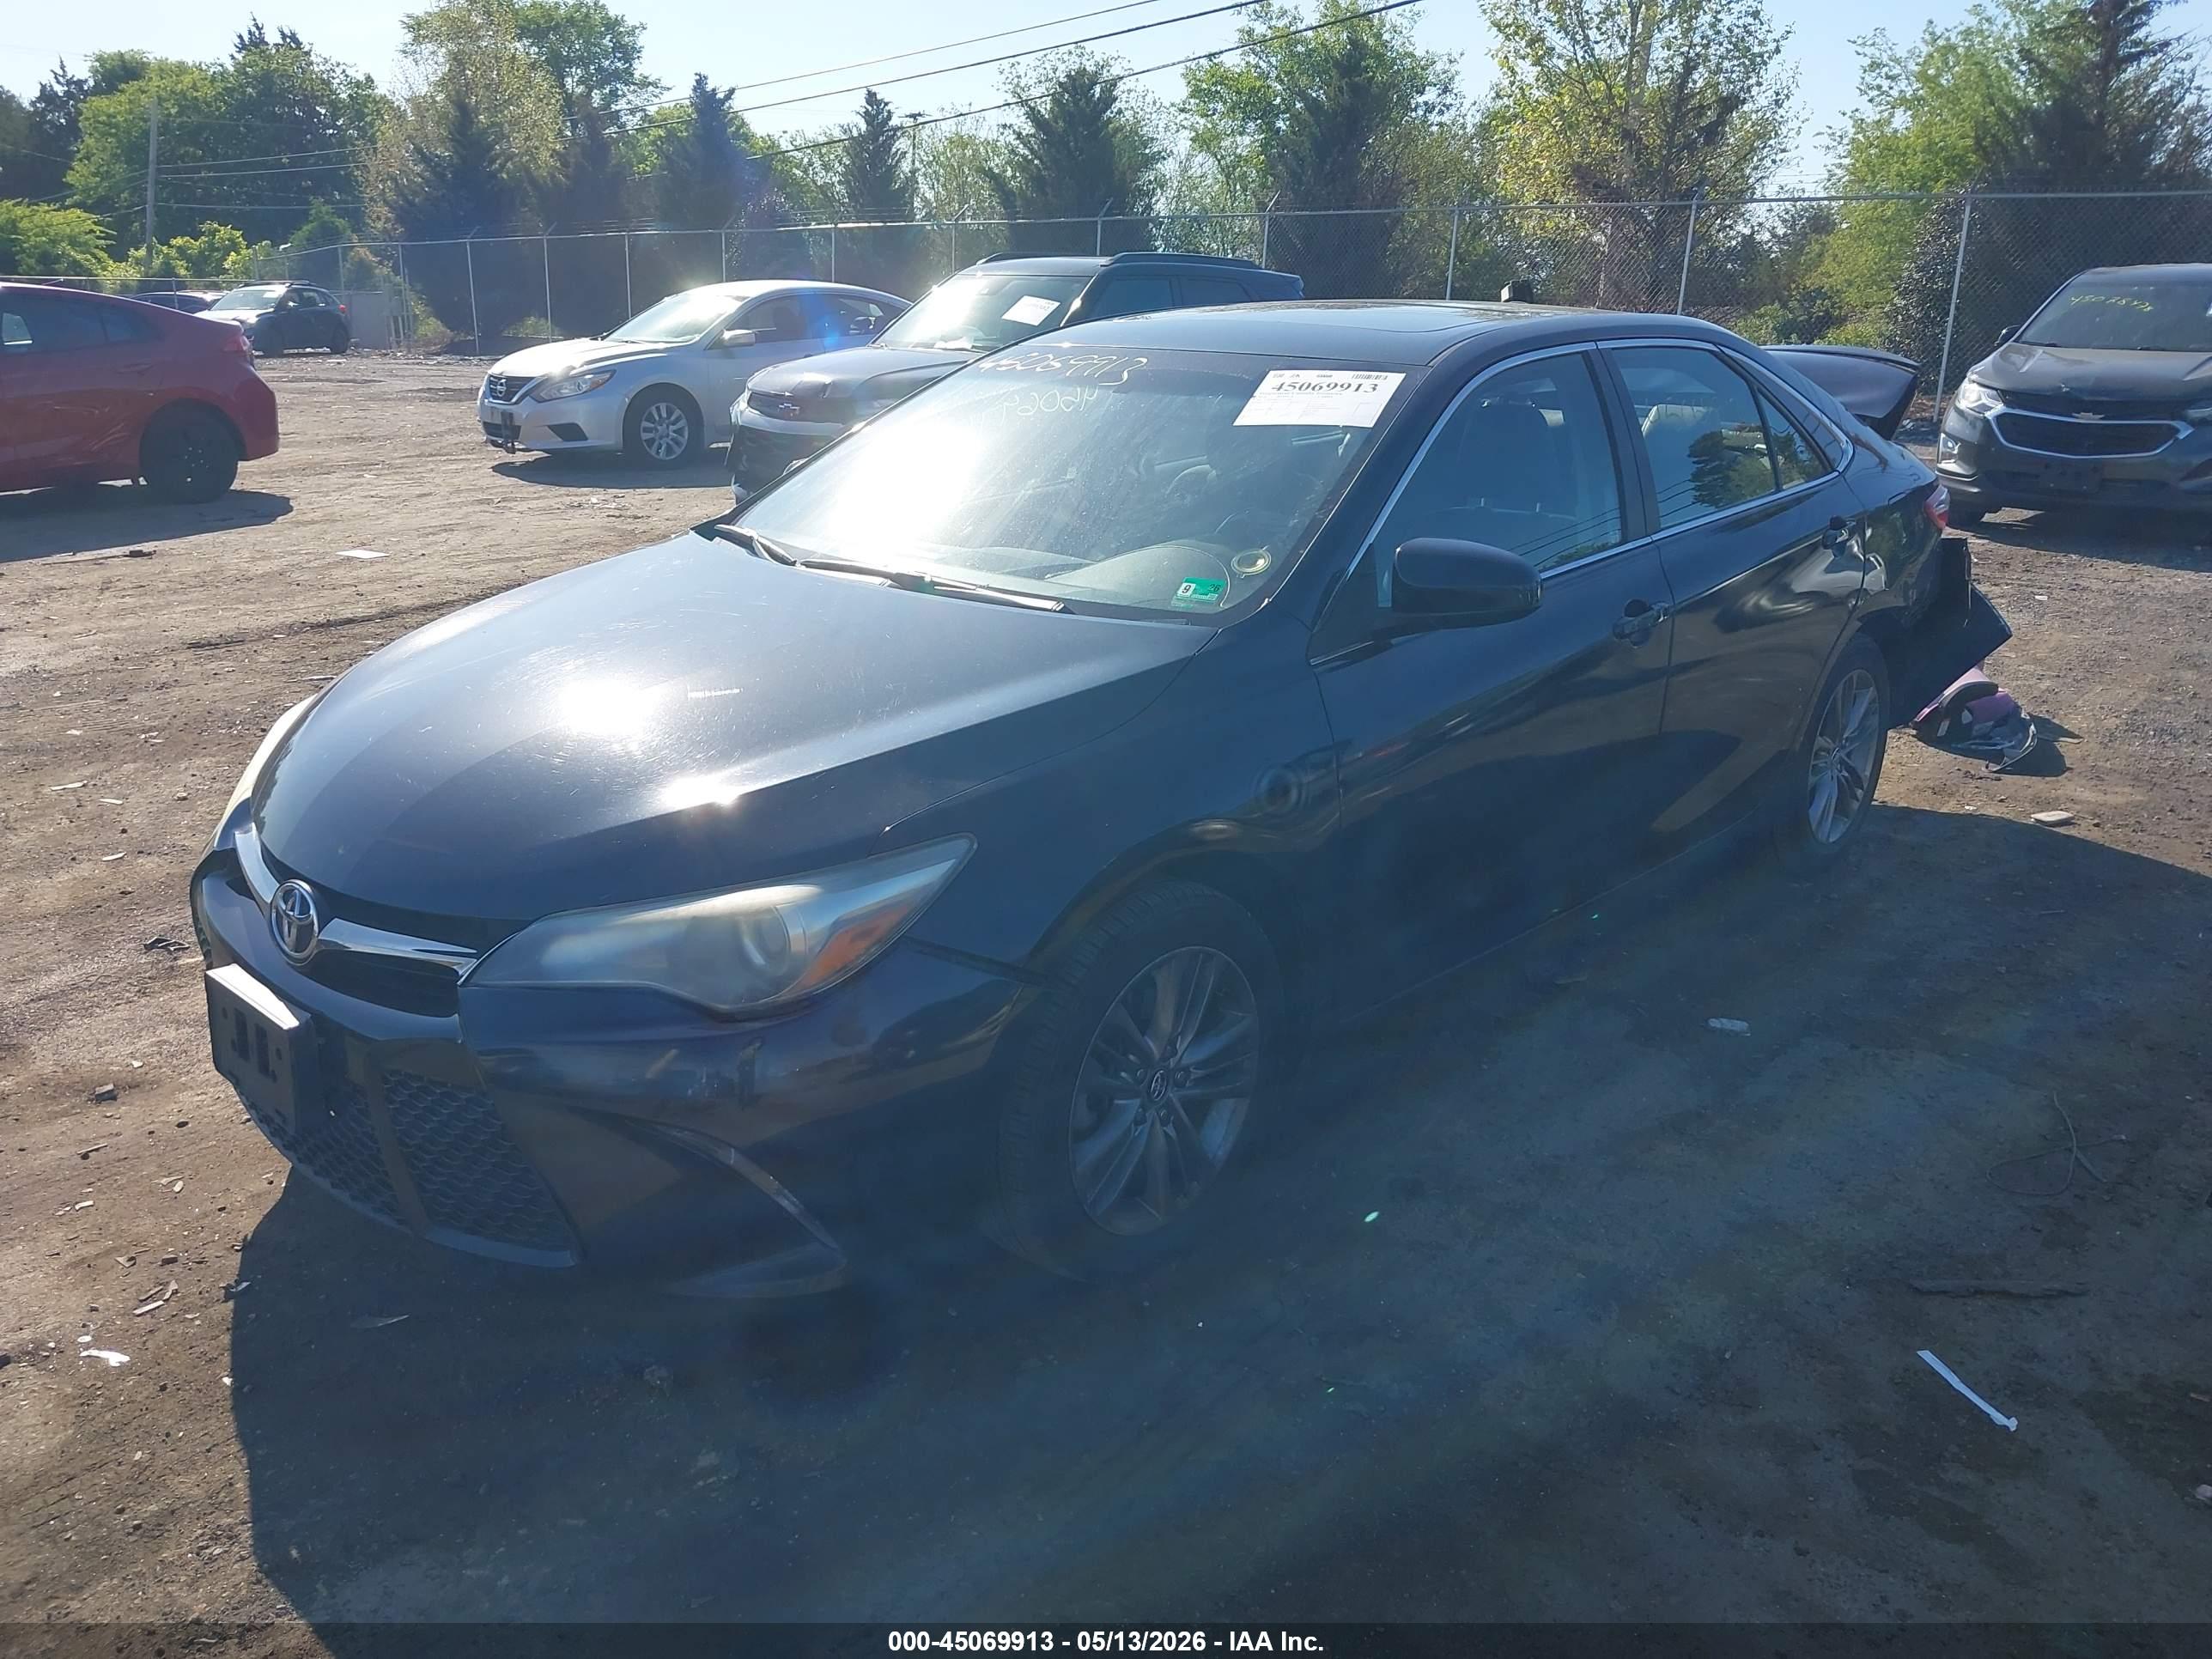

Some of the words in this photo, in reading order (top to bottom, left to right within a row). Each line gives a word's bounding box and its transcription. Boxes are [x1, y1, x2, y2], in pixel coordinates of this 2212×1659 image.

[979, 353, 1148, 386] 45069913
[1272, 381, 1379, 393] 45069913
[1182, 584, 1191, 593] 9
